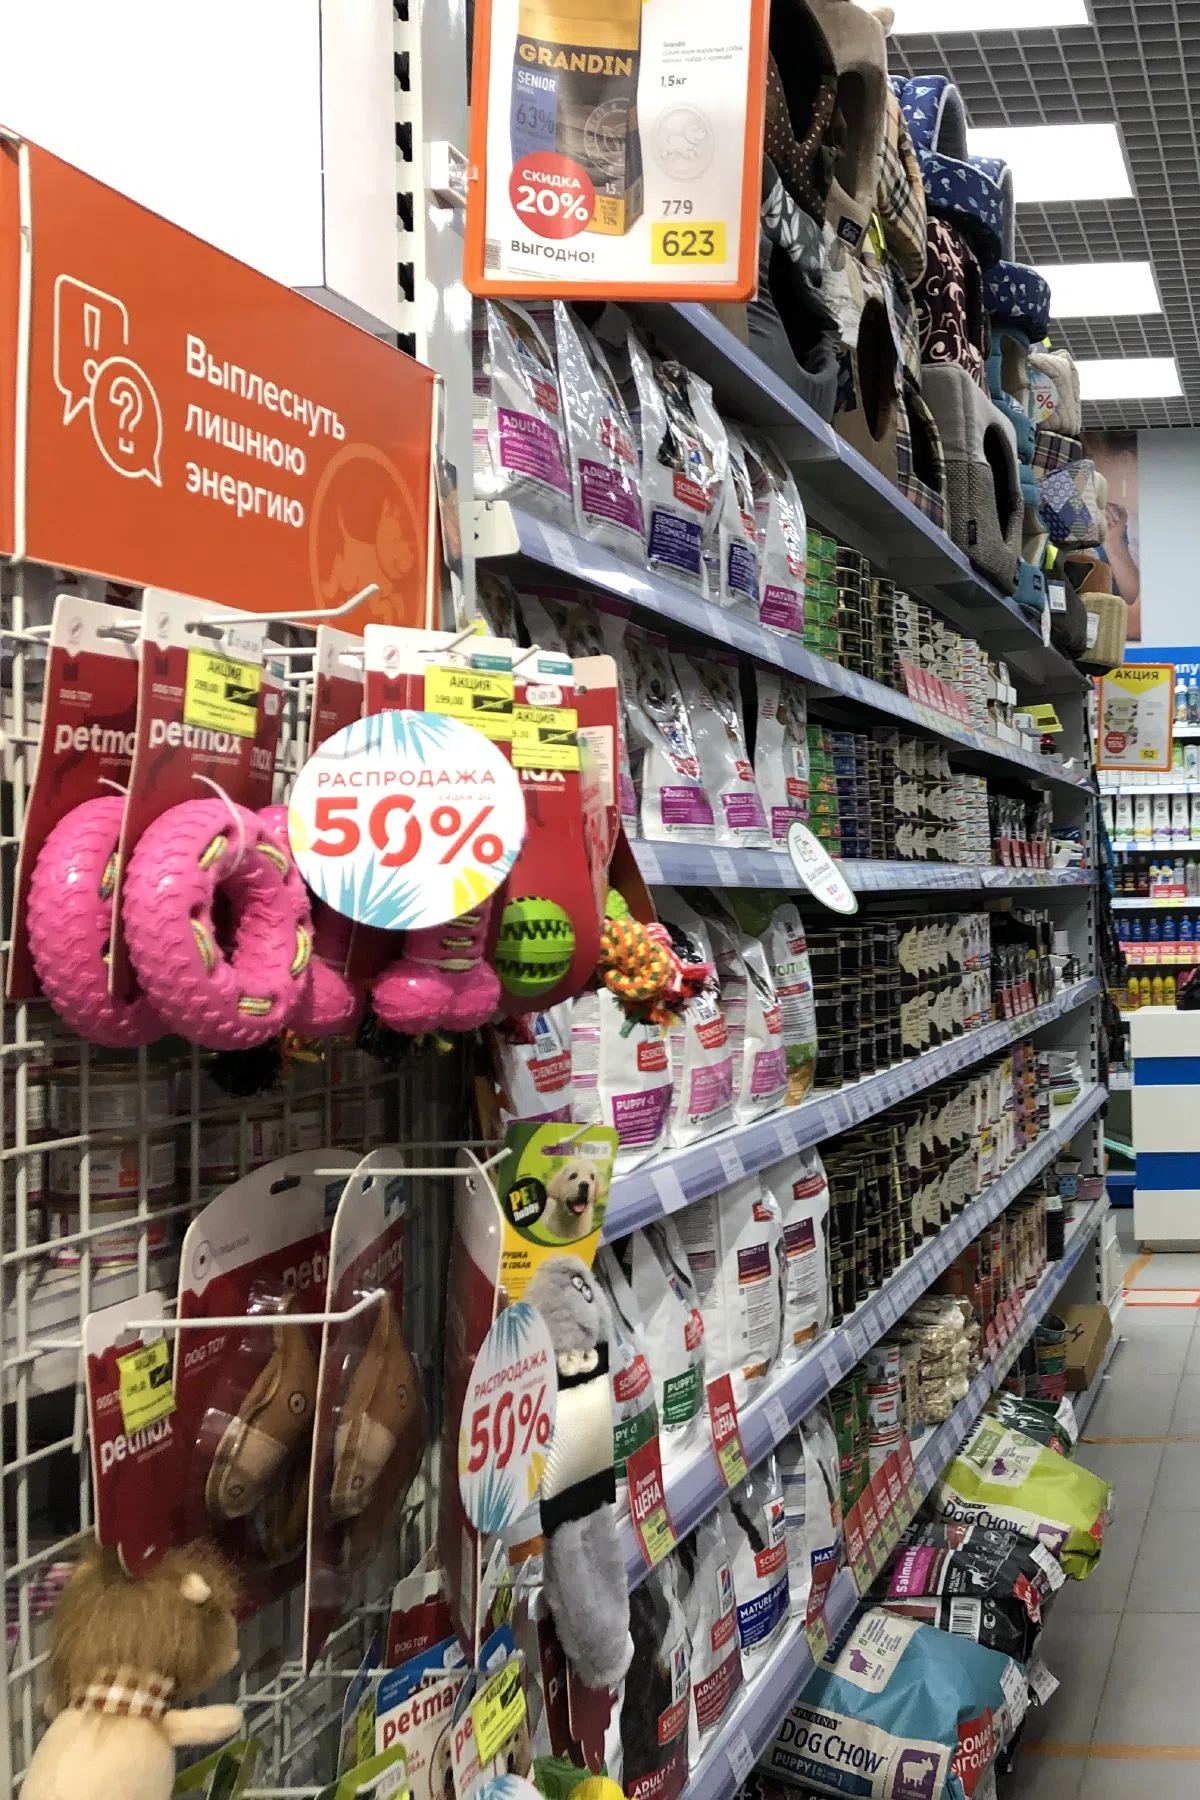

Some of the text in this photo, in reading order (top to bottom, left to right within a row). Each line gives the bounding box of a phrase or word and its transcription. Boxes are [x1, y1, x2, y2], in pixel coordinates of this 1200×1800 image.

[519, 43, 633, 77] GRANDIN
[517, 71, 556, 92] SENIOR
[516, 103, 555, 133] 63%
[522, 169, 581, 189] СКИДКА
[516, 186, 589, 221] 20%
[662, 200, 693, 215] 779
[511, 240, 595, 263] ВЫГОДНО!
[662, 230, 715, 256] 623
[186, 334, 346, 441] Выплеснуть
[186, 404, 306, 476] лишнюю
[186, 463, 304, 528] энергию
[449, 676, 492, 691] АКЦИЯ
[1114, 670, 1159, 681] АКЦИЯ
[515, 712, 556, 724] АКЦИЯ
[149, 718, 242, 755] petmax
[317, 769, 496, 788] РАСПРОДАЖА
[310, 793, 504, 868] 50%
[616, 1098, 646, 1112] PUPPY
[474, 1349, 548, 1400] РАСПРОДАЖА
[667, 1374, 695, 1393] PUPPY
[467, 1384, 551, 1474] 50%
[713, 1413, 737, 1441] ЦЕНА
[634, 1485, 662, 1519] ЦЕНА
[943, 1500, 976, 1525] DOG
[896, 1558, 913, 1593] Salmon
[740, 1594, 772, 1619] MATURE
[697, 1675, 719, 1698] ADULT
[798, 1708, 837, 1730] PURINA
[777, 1718, 884, 1774] DOG CHOW
[774, 1751, 812, 1774] PUPPY
[633, 1765, 666, 1799] ADULT
